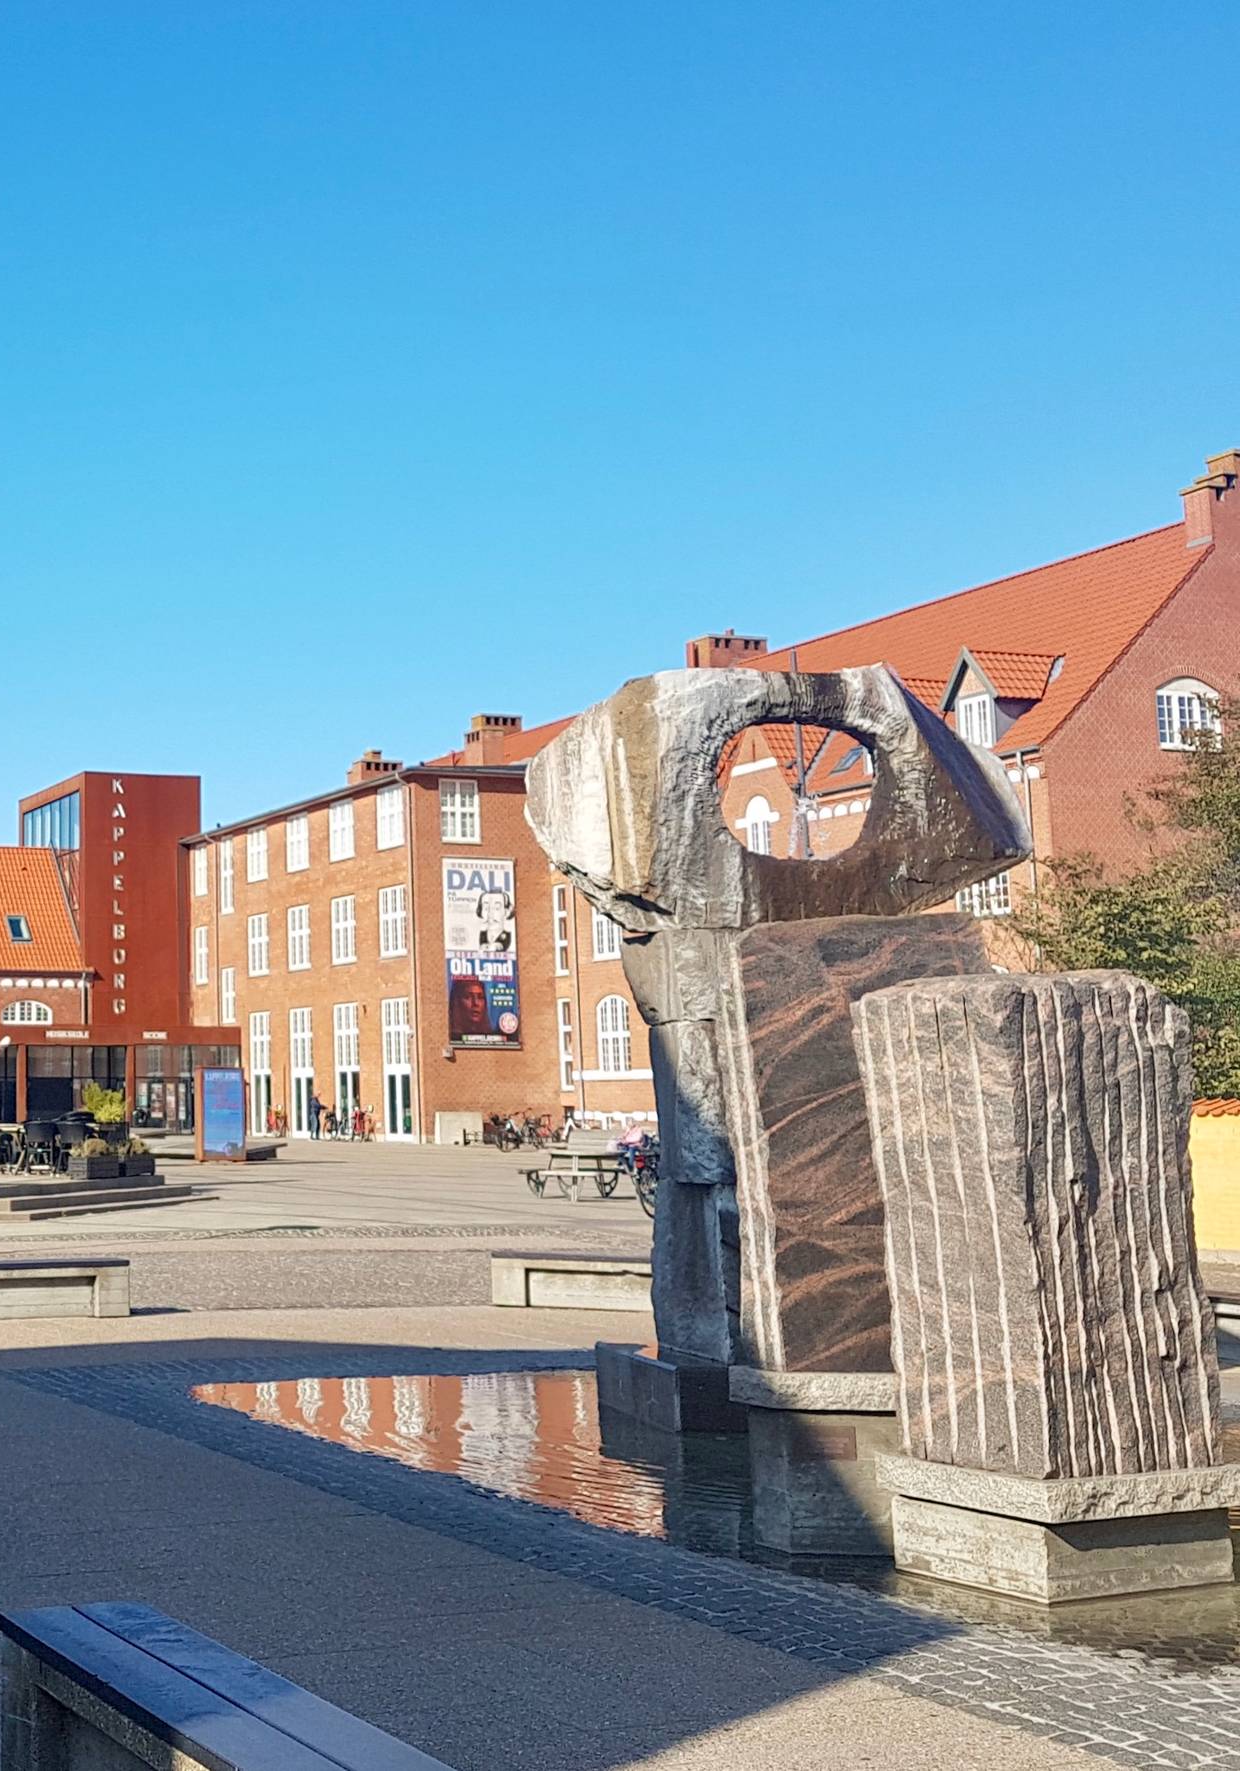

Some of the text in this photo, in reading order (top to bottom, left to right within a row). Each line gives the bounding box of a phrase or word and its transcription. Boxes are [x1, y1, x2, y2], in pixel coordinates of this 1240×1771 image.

[447, 869, 510, 893] DALI
[112, 778, 126, 1015] KAPPELBORG
[450, 958, 513, 976] Oh Land
